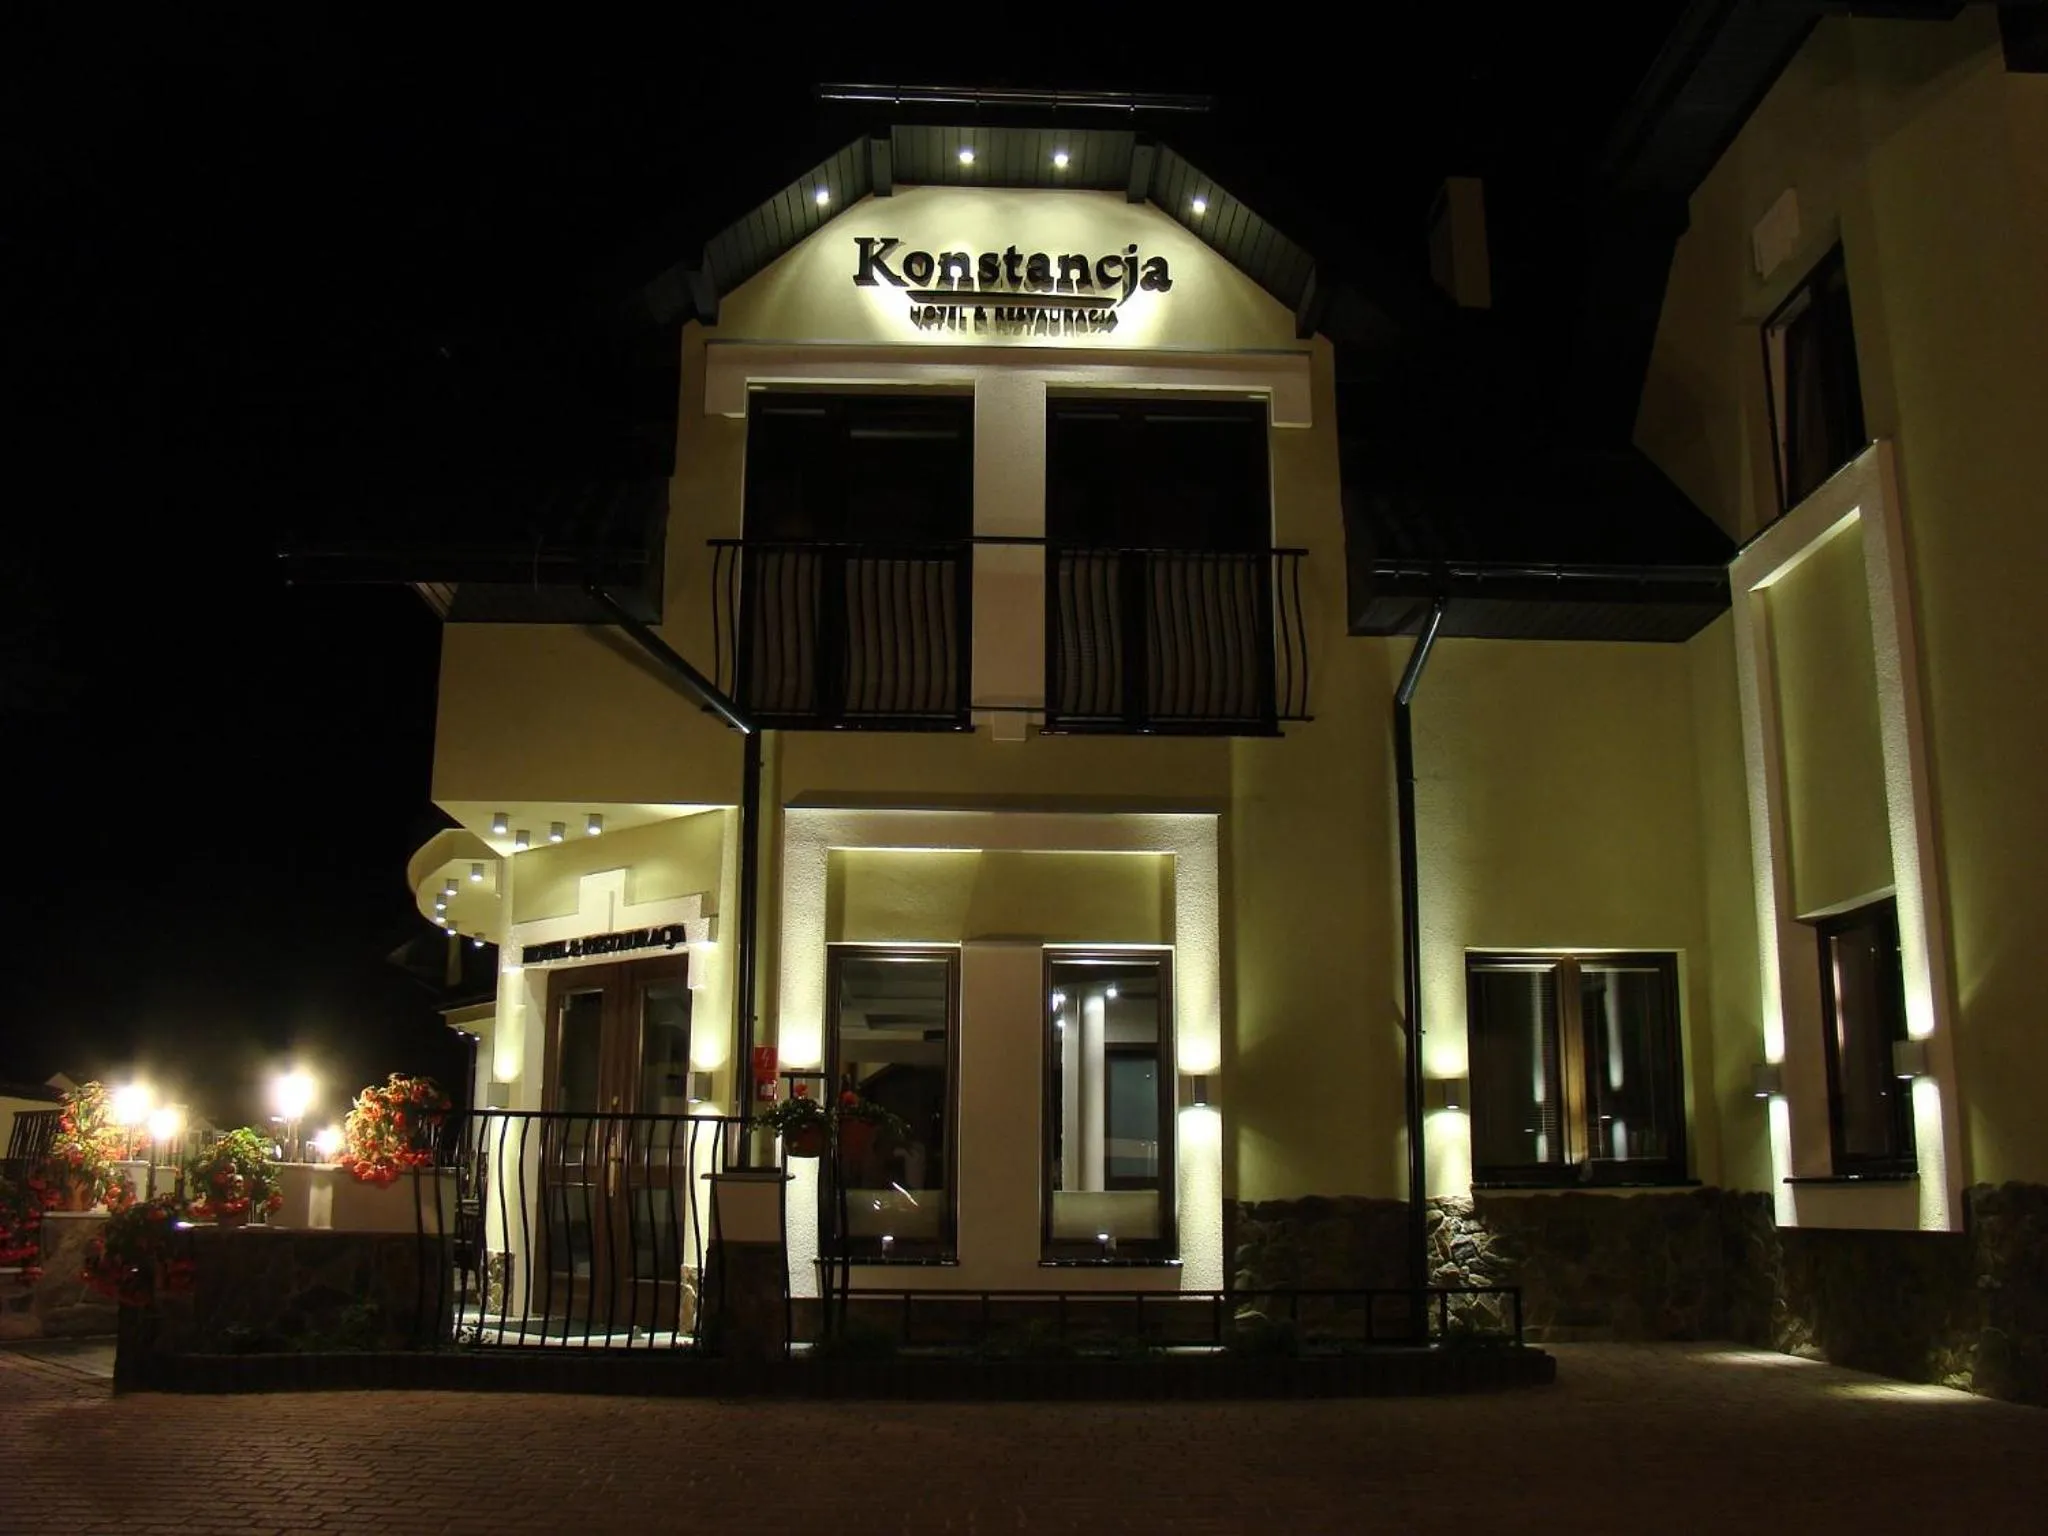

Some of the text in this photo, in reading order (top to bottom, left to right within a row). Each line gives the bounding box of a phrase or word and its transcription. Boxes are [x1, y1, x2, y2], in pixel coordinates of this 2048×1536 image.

[853, 237, 1173, 307] Konstancja
[910, 306, 1119, 332] HOTEL & RESTAURACJA
